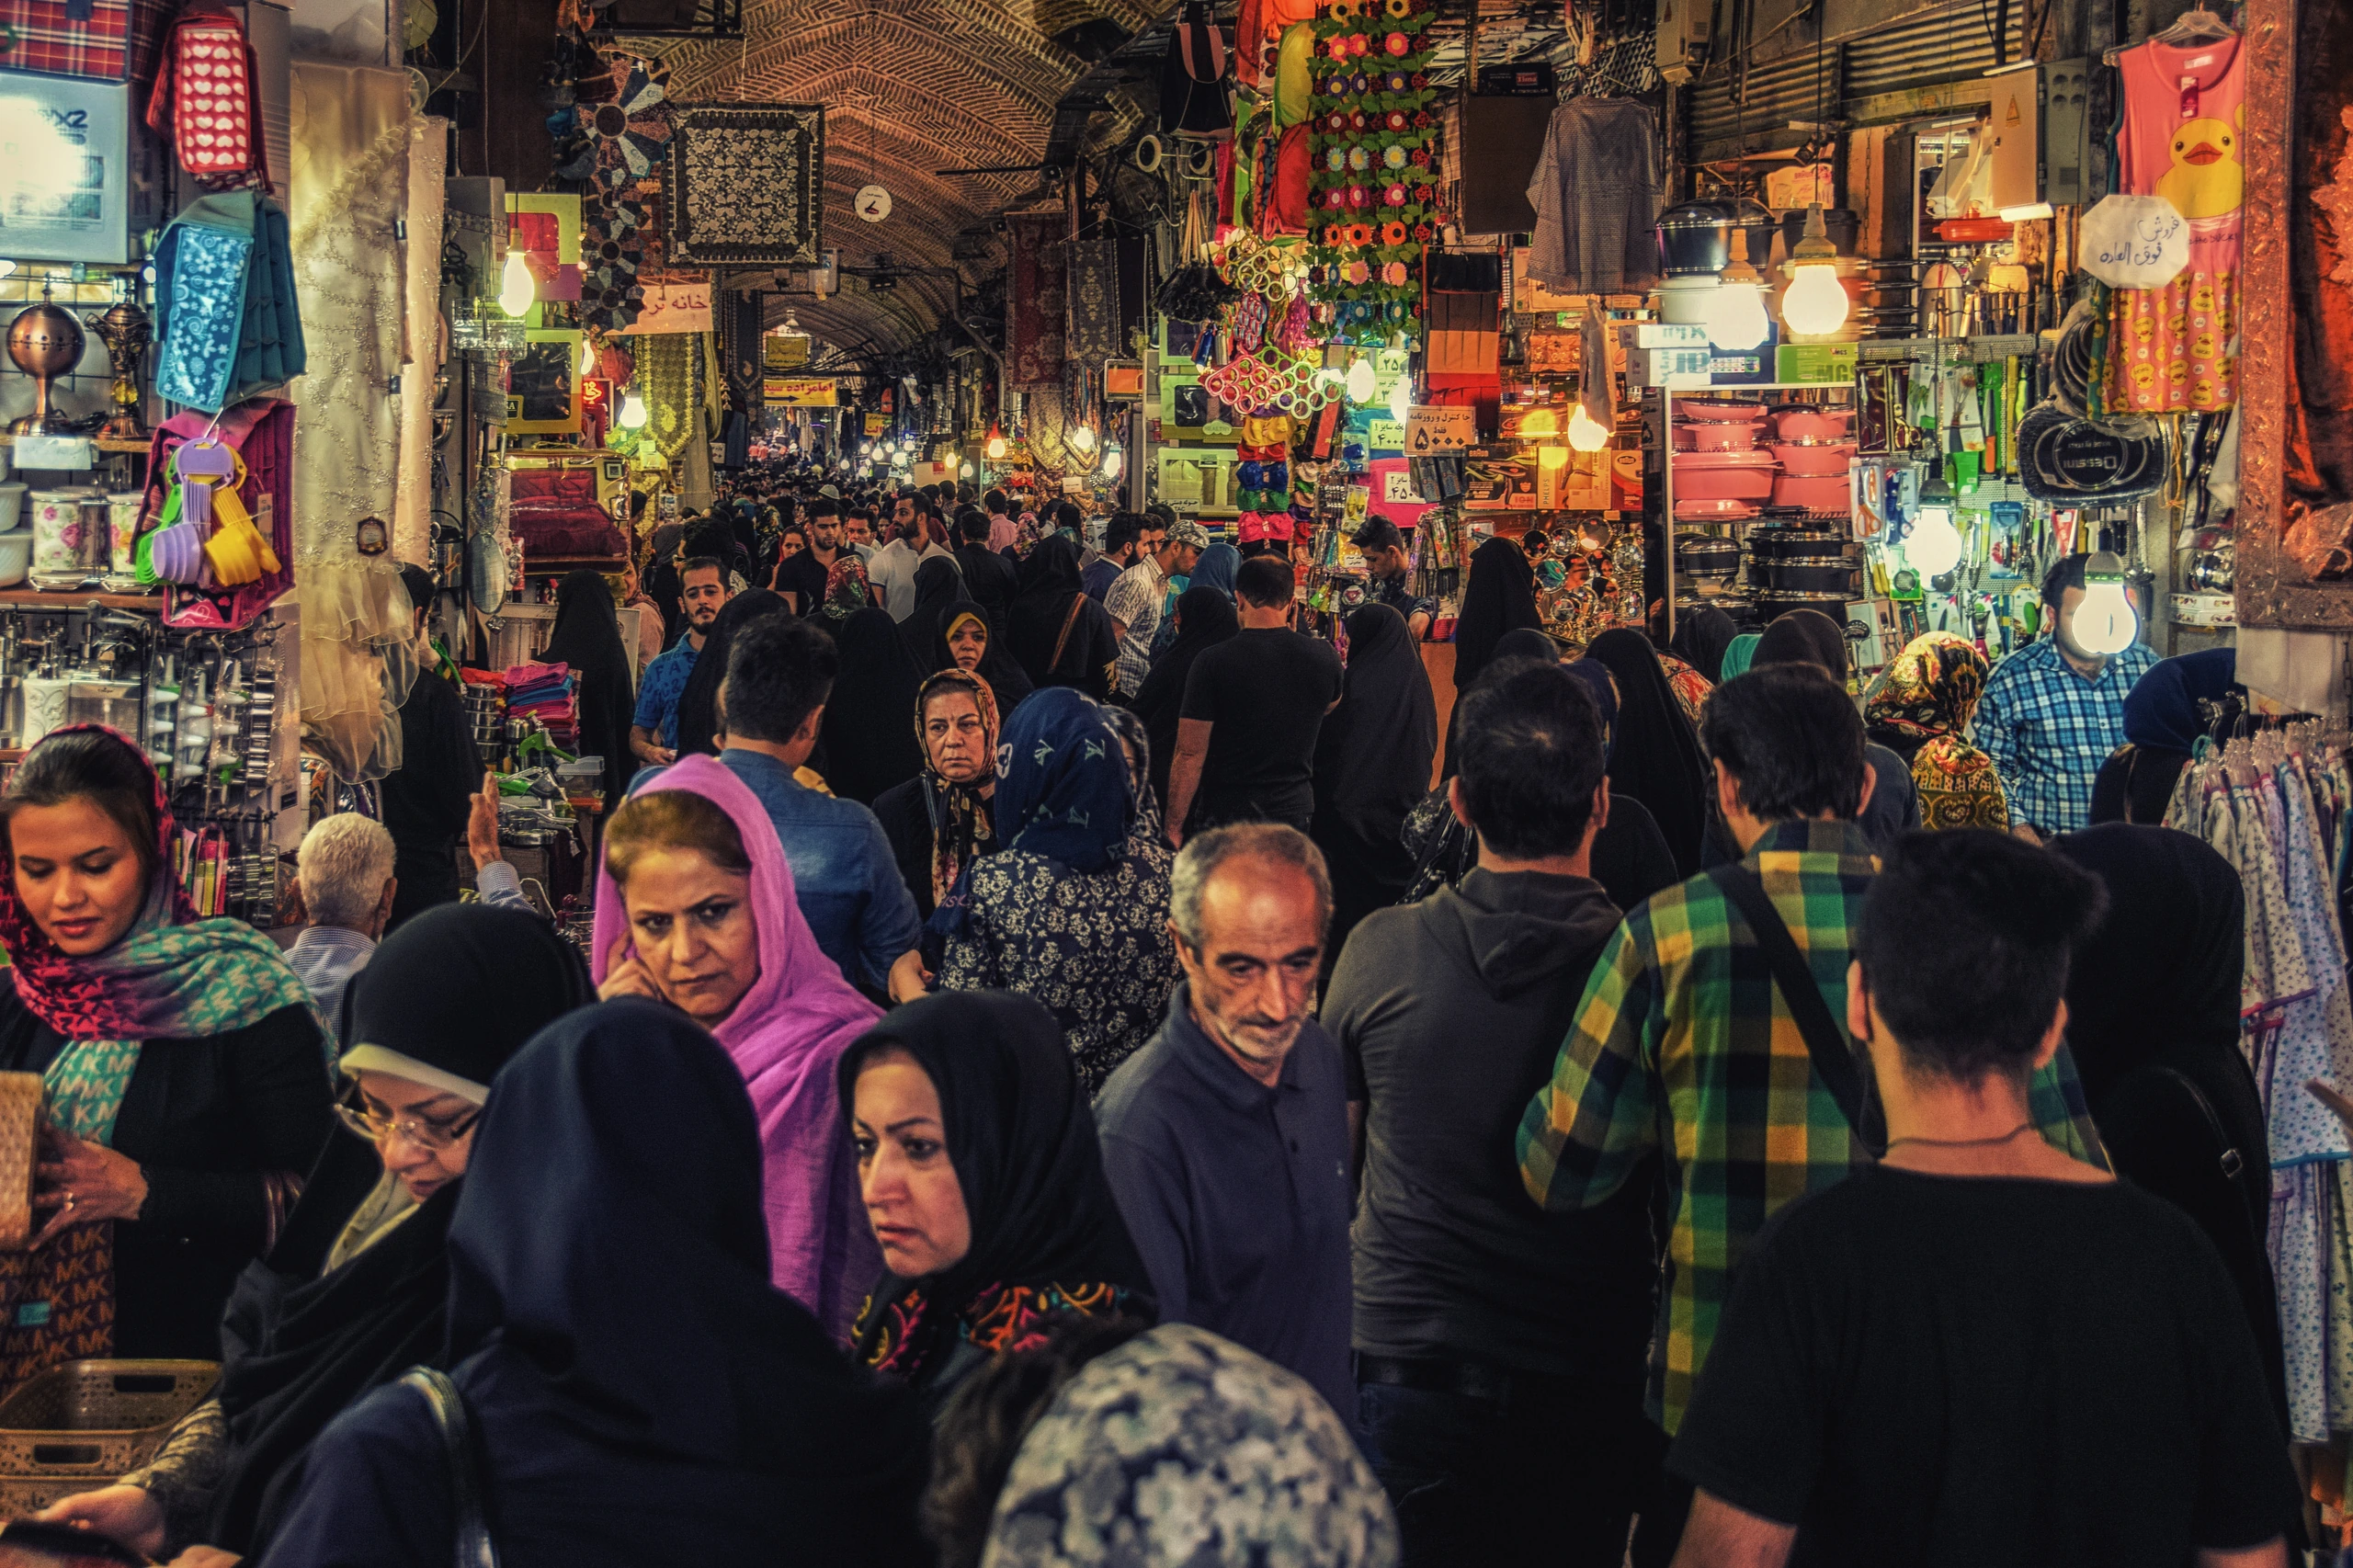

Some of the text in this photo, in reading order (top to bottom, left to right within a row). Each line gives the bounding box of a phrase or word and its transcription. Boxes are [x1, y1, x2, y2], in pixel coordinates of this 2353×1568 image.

[2137, 216, 2179, 242] فروش
[2099, 242, 2162, 266] فوق العاده
[672, 294, 708, 310] خانه
